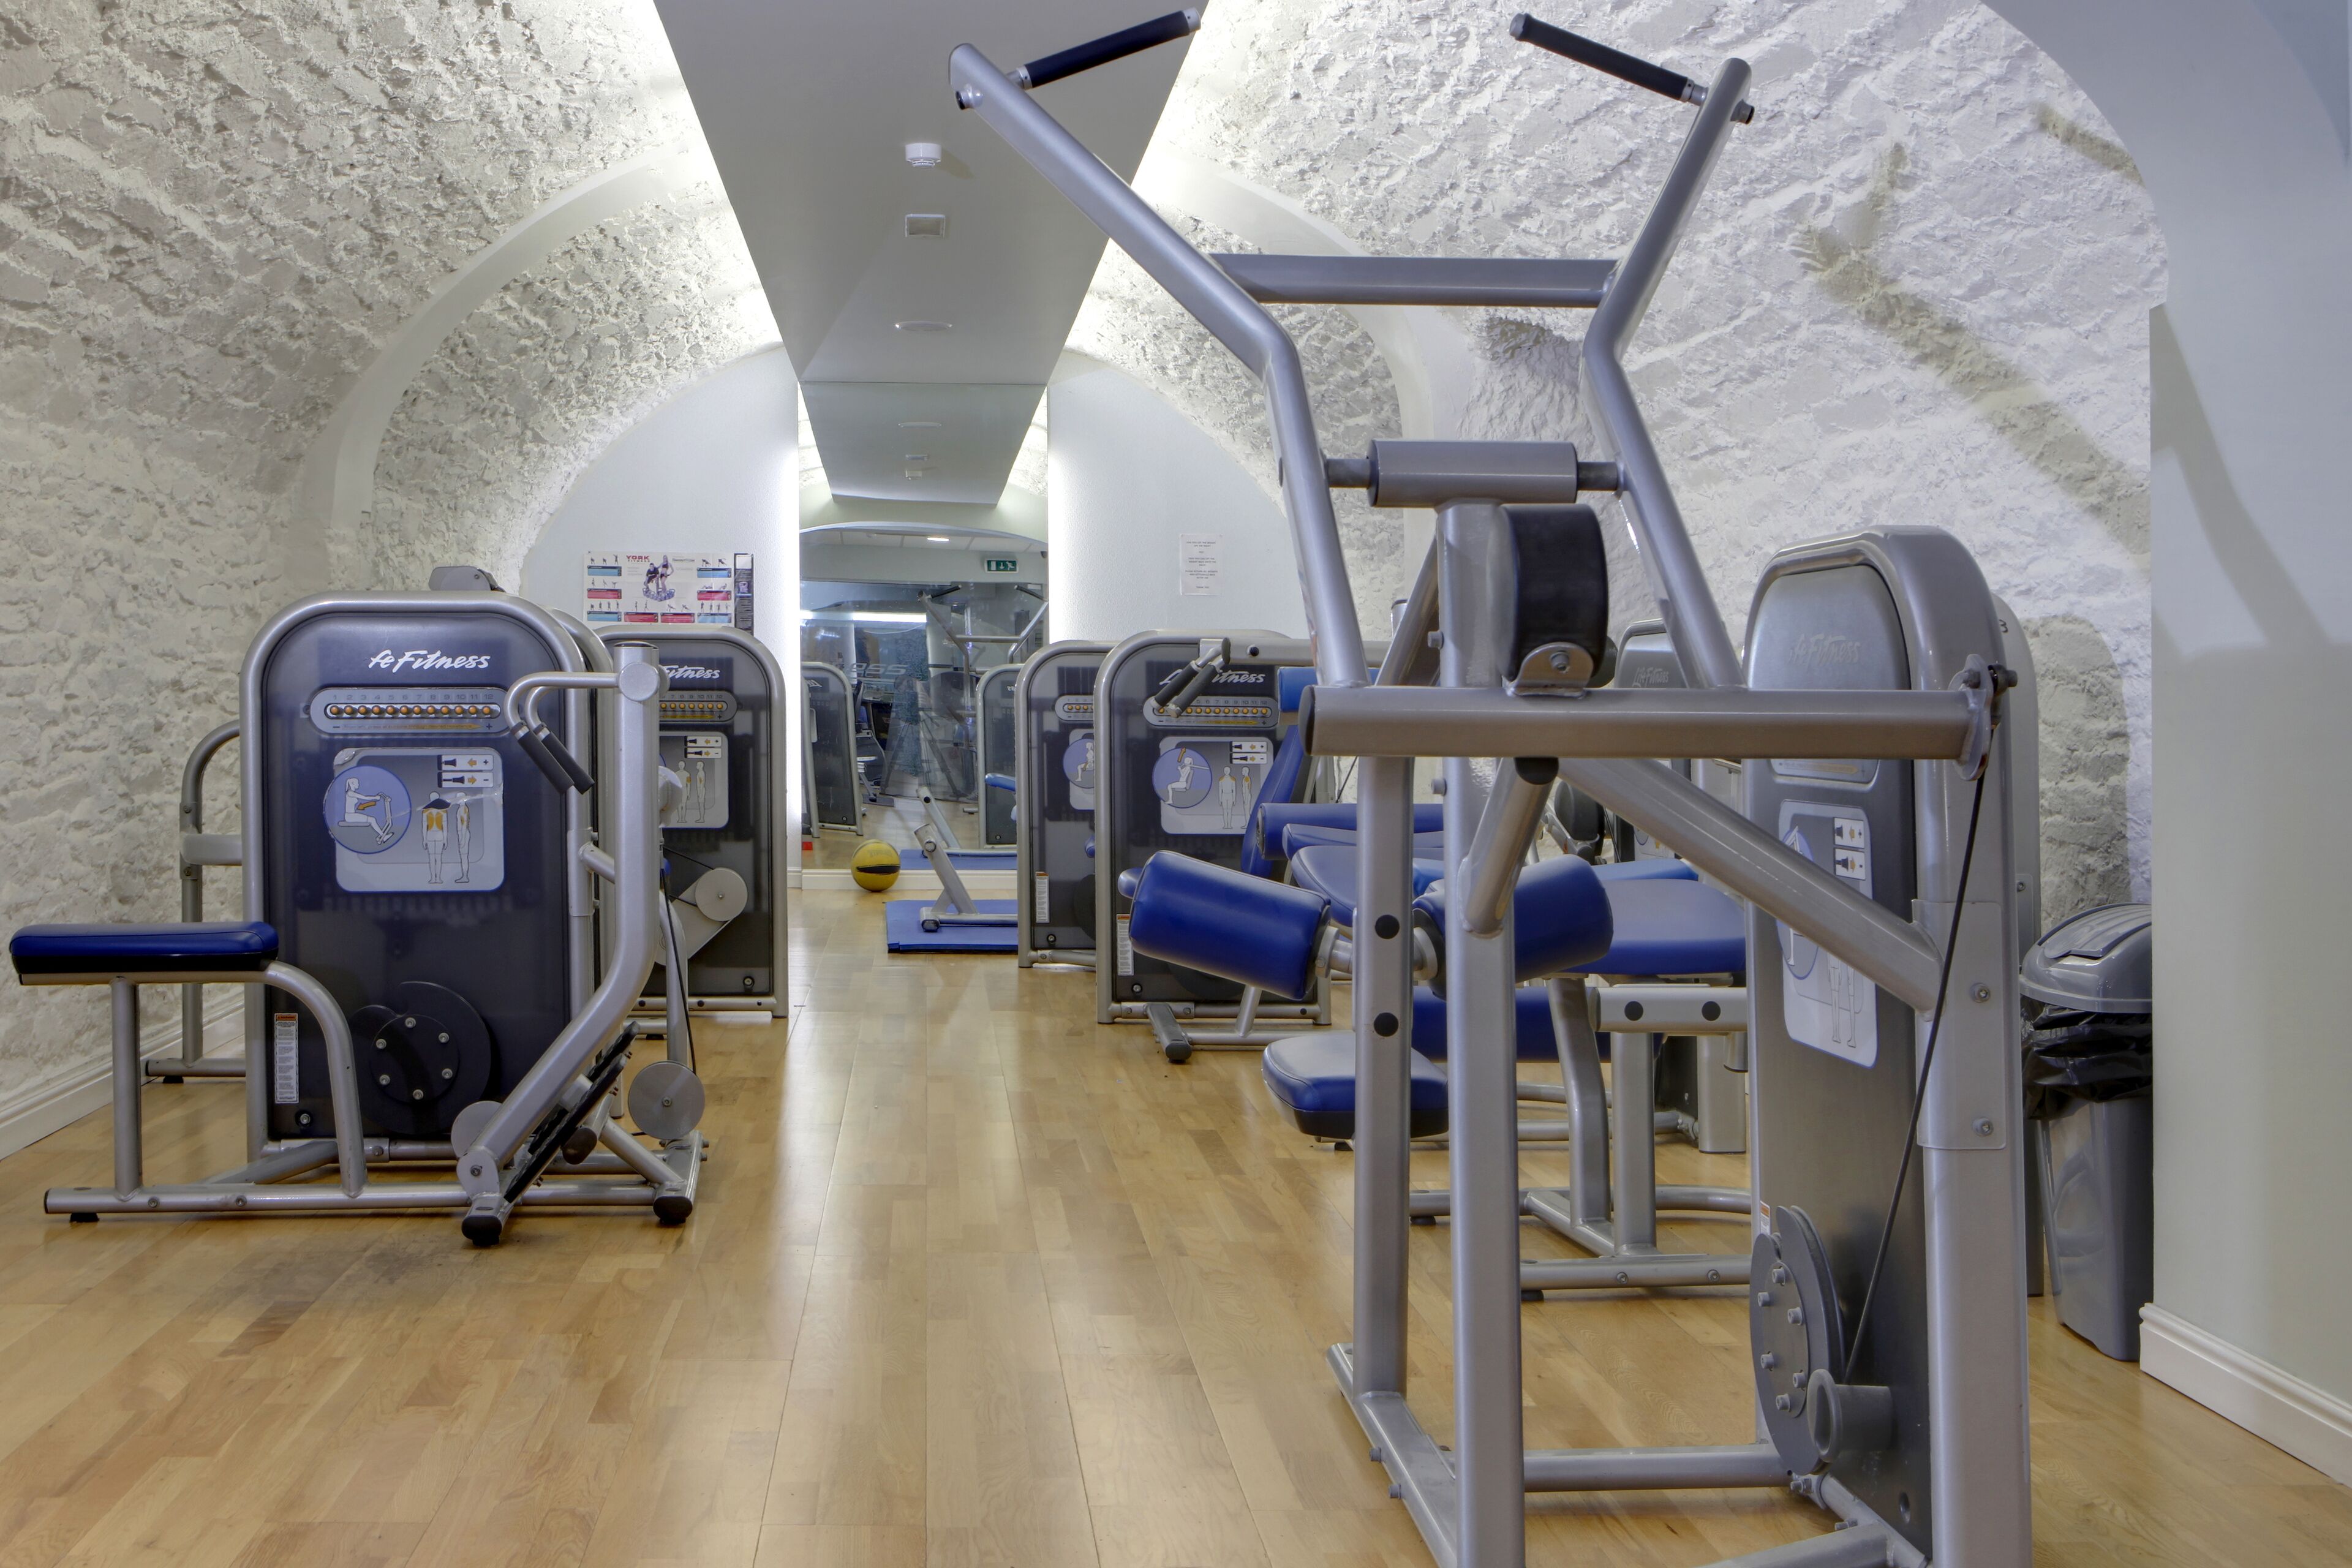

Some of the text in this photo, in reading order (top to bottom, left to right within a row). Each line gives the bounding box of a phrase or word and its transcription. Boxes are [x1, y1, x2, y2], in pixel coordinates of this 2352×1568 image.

[392, 650, 491, 673] Fitness
[1806, 633, 1861, 672] Fitness
[1212, 669, 1266, 684] itness
